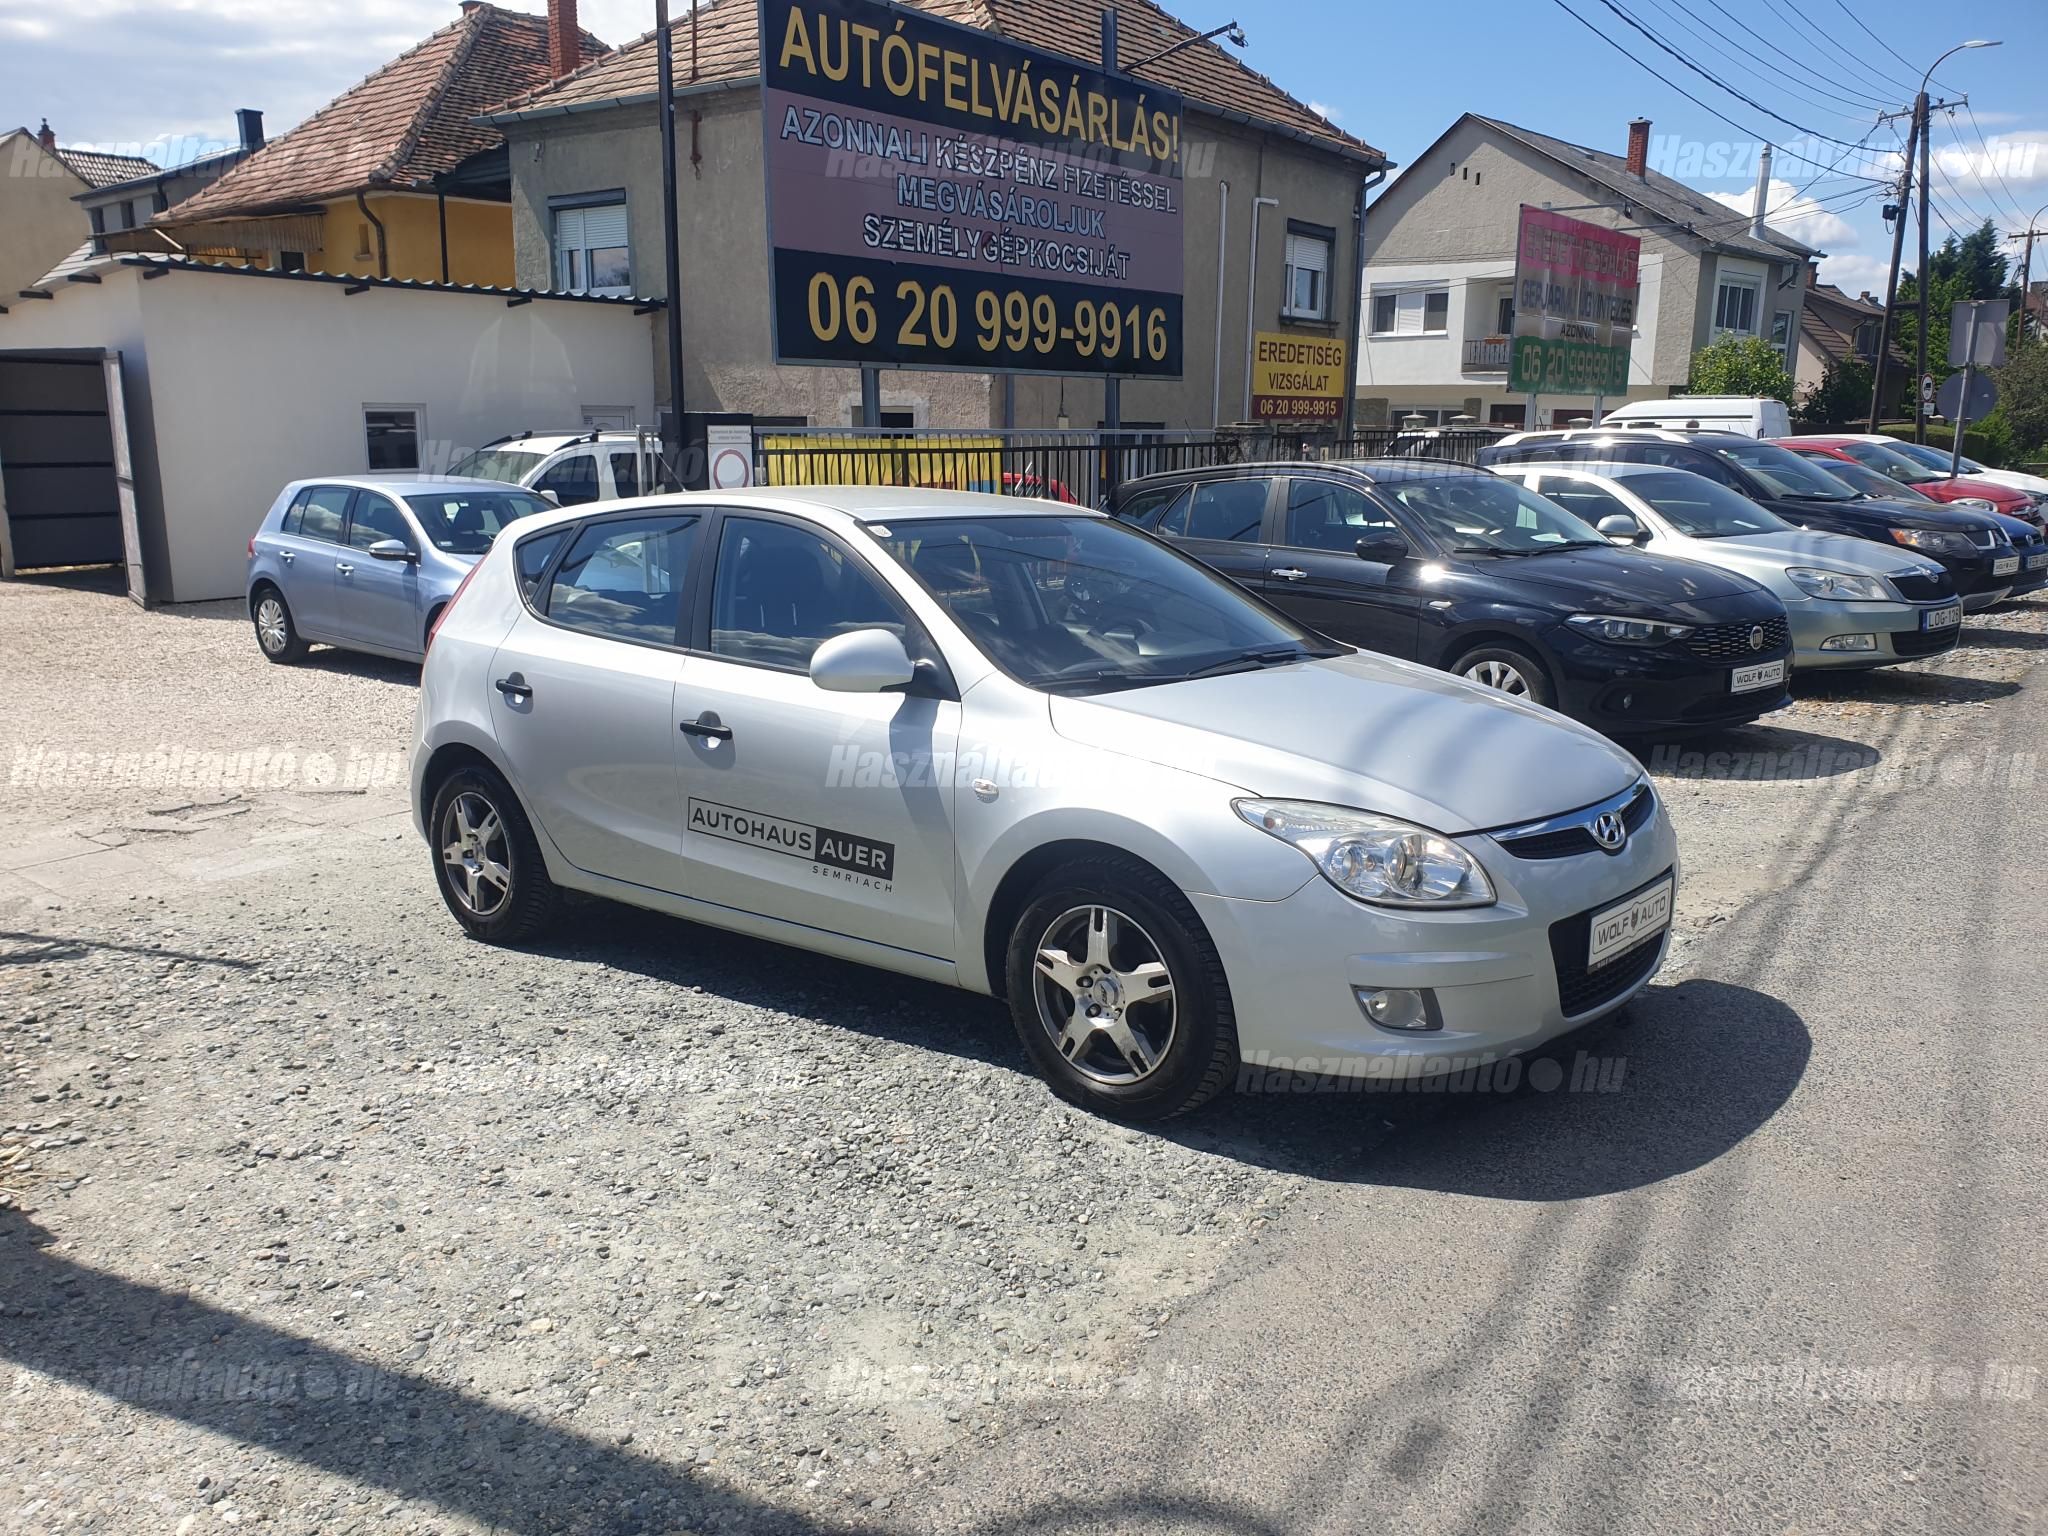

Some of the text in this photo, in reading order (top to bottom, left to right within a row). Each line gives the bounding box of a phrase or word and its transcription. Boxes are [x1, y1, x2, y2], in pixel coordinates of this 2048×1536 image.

[779, 6, 1179, 162] AUTÓFELVÁSÁRLÁS!
[781, 106, 1177, 213] AZONNALI KÉSZPÉNZ FIZETÉSSEL
[897, 174, 1105, 238] MEGVÁSÁROLJUK
[808, 272, 1167, 361] 06 20 999-9916
[1258, 341, 1341, 366] EREDETISÉG
[1521, 344, 1542, 381] 06
[1546, 347, 1565, 384] 20
[1268, 370, 1329, 391] VIZSGÁLAT
[1261, 399, 1336, 415] 06 20 999-9915
[1736, 667, 1780, 684] WOLF AUTO
[692, 807, 887, 870] AUTOHAUS AUER
[812, 865, 893, 893] SEMRIACH
[1598, 895, 1666, 945] WOLF AUTO
